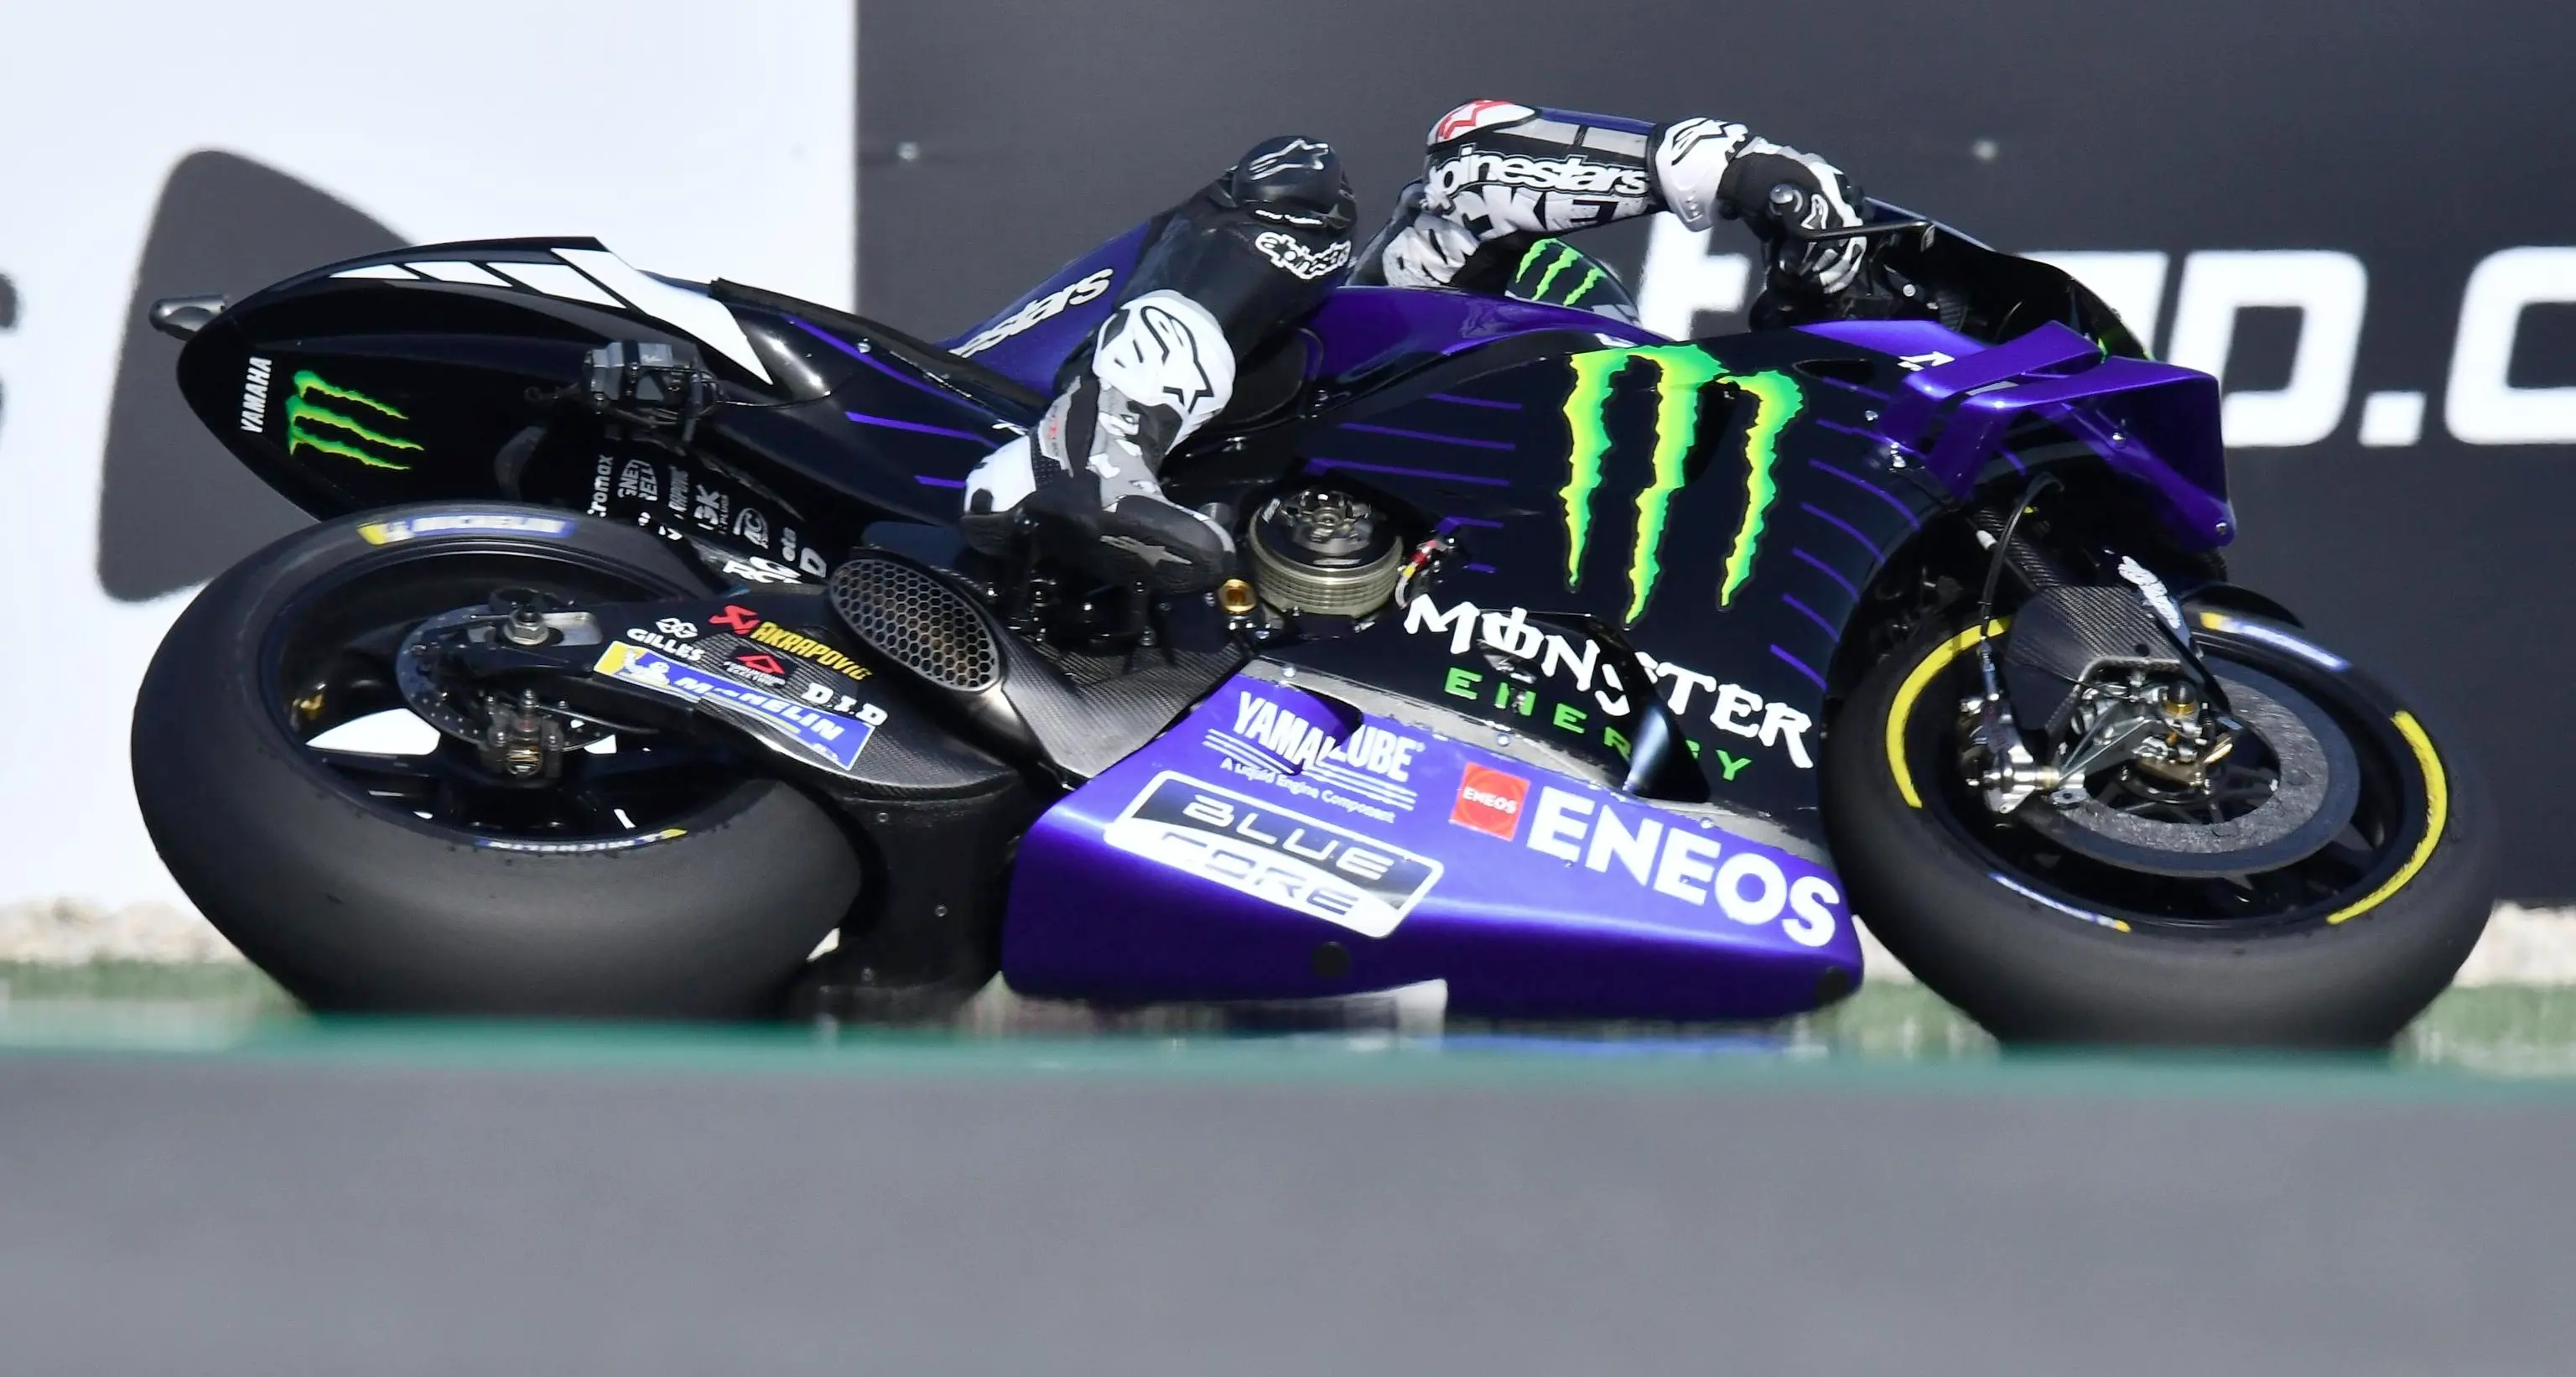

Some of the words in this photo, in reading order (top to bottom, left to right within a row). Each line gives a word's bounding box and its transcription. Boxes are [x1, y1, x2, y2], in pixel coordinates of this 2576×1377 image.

[241, 356, 272, 433] YAMAHA
[626, 628, 706, 662] GILLES
[801, 682, 889, 726] D.I.D
[1220, 756, 1233, 771] A
[1275, 772, 1320, 799] Engine
[1321, 789, 1396, 824] Component
[1462, 786, 1519, 814] ENEOS
[1182, 793, 1395, 881] BLUE
[1526, 786, 1841, 948] ENEOS
